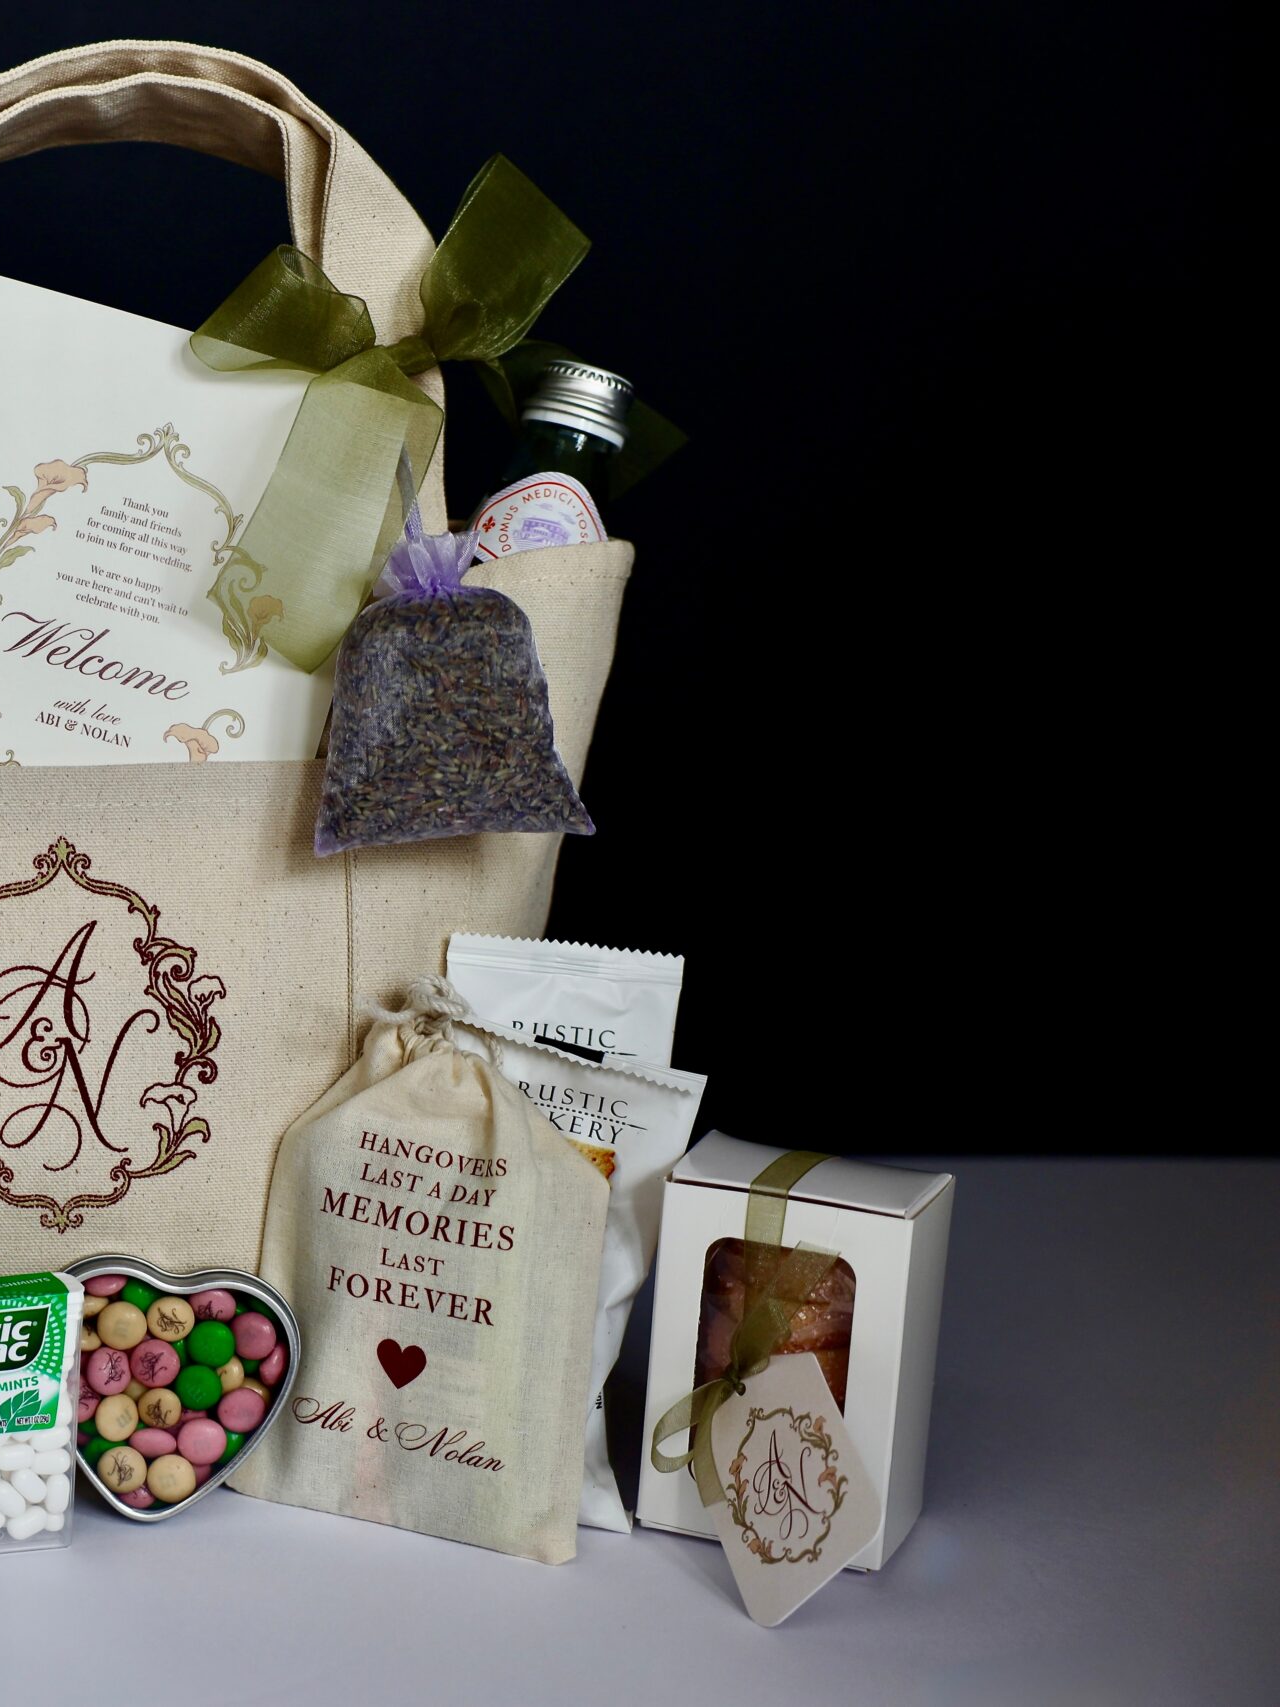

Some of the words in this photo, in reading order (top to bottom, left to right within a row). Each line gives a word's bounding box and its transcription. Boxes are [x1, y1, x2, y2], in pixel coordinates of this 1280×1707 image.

[100, 506, 130, 523] family
[130, 516, 148, 528] and
[149, 520, 182, 538] friends
[122, 497, 150, 513] Thank
[151, 507, 169, 519] you
[499, 505, 519, 553] DOMUS
[521, 488, 573, 505] MEDICI
[75, 529, 85, 539] to
[87, 533, 105, 546] join
[106, 540, 117, 550] us
[118, 542, 133, 554] for
[134, 549, 151, 559] our
[152, 554, 193, 573] wedding.
[87, 517, 101, 528] for
[102, 523, 137, 540] coming
[137, 533, 149, 543] all
[151, 537, 168, 549] this
[170, 544, 187, 556] way
[56, 571, 74, 583] you
[75, 576, 90, 587] are
[91, 579, 113, 594] here
[114, 588, 132, 600] and
[157, 602, 177, 614] wait
[178, 606, 188, 617] to
[91, 564, 104, 576] We
[105, 570, 121, 581] are
[122, 576, 133, 585] so
[134, 577, 163, 594] happy
[75, 592, 118, 611] celebrate
[119, 606, 140, 618] with
[140, 612, 160, 624] you.
[1, 611, 191, 701] Welcome
[35, 711, 62, 727] ABI
[64, 718, 77, 732] &
[80, 722, 132, 749] NOLAN
[53, 698, 86, 717] with
[91, 700, 122, 726] love
[518, 1080, 629, 1119] RUSTIC
[548, 1110, 624, 1145] KERY
[358, 1130, 508, 1178] HANGOVERS
[360, 1162, 423, 1193] LAST
[427, 1182, 442, 1200] A
[449, 1184, 496, 1208] DAY
[320, 1187, 515, 1251] MEMORIES
[379, 1248, 445, 1277] LAST
[326, 1265, 495, 1327] FOREVER
[291, 1396, 356, 1433] Abi
[366, 1416, 389, 1442] &
[394, 1421, 505, 1472] Nolan
